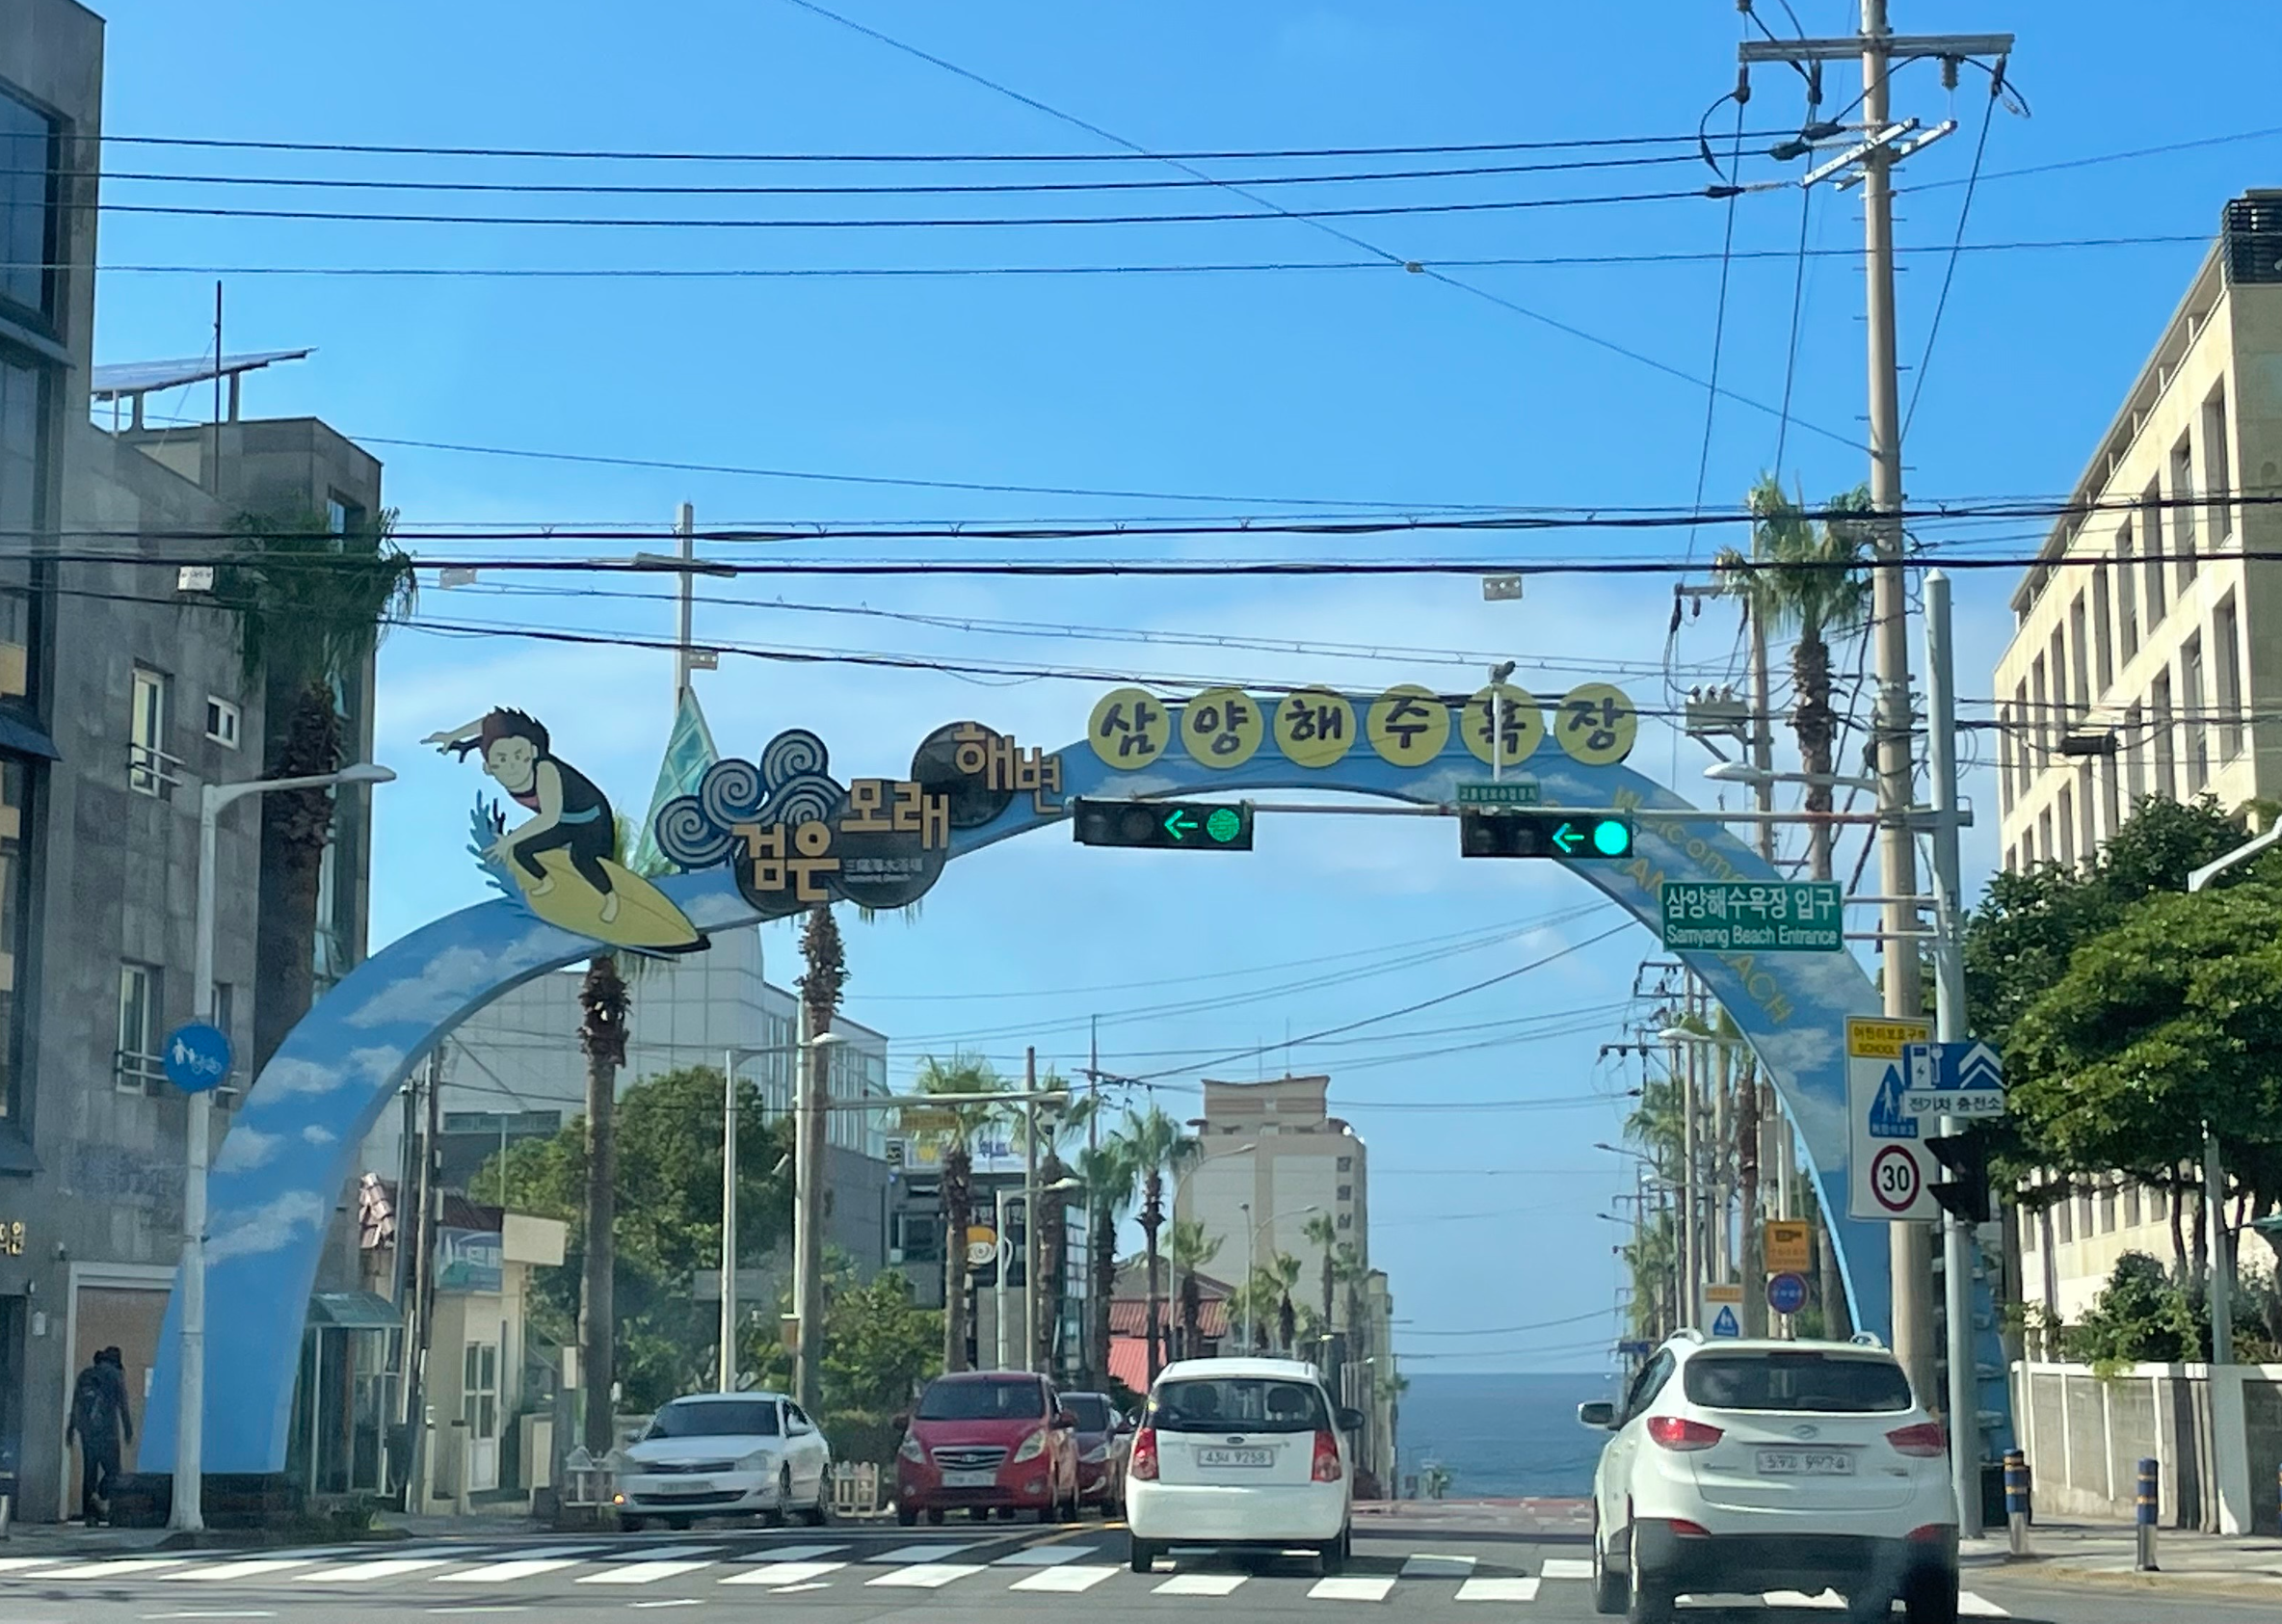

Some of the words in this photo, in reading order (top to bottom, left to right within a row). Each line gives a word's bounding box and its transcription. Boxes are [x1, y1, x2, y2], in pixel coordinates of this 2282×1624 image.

[1100, 695, 1625, 757] 삼양해수욕장
[731, 820, 840, 902] 검은
[840, 777, 949, 850] 모래
[952, 721, 1064, 813] 해변
[1666, 886, 1788, 920] 삼양해수욕장
[1794, 887, 1837, 920] 입구
[1666, 924, 1730, 948] Samyang
[1732, 924, 1775, 945] Beach
[1778, 924, 1838, 945] Entrance
[1858, 1043, 1897, 1055] SCHOOL
[1909, 1096, 1951, 1112] 전기차
[1956, 1096, 2002, 1112] 충전소
[1882, 1164, 1910, 1192] 30
